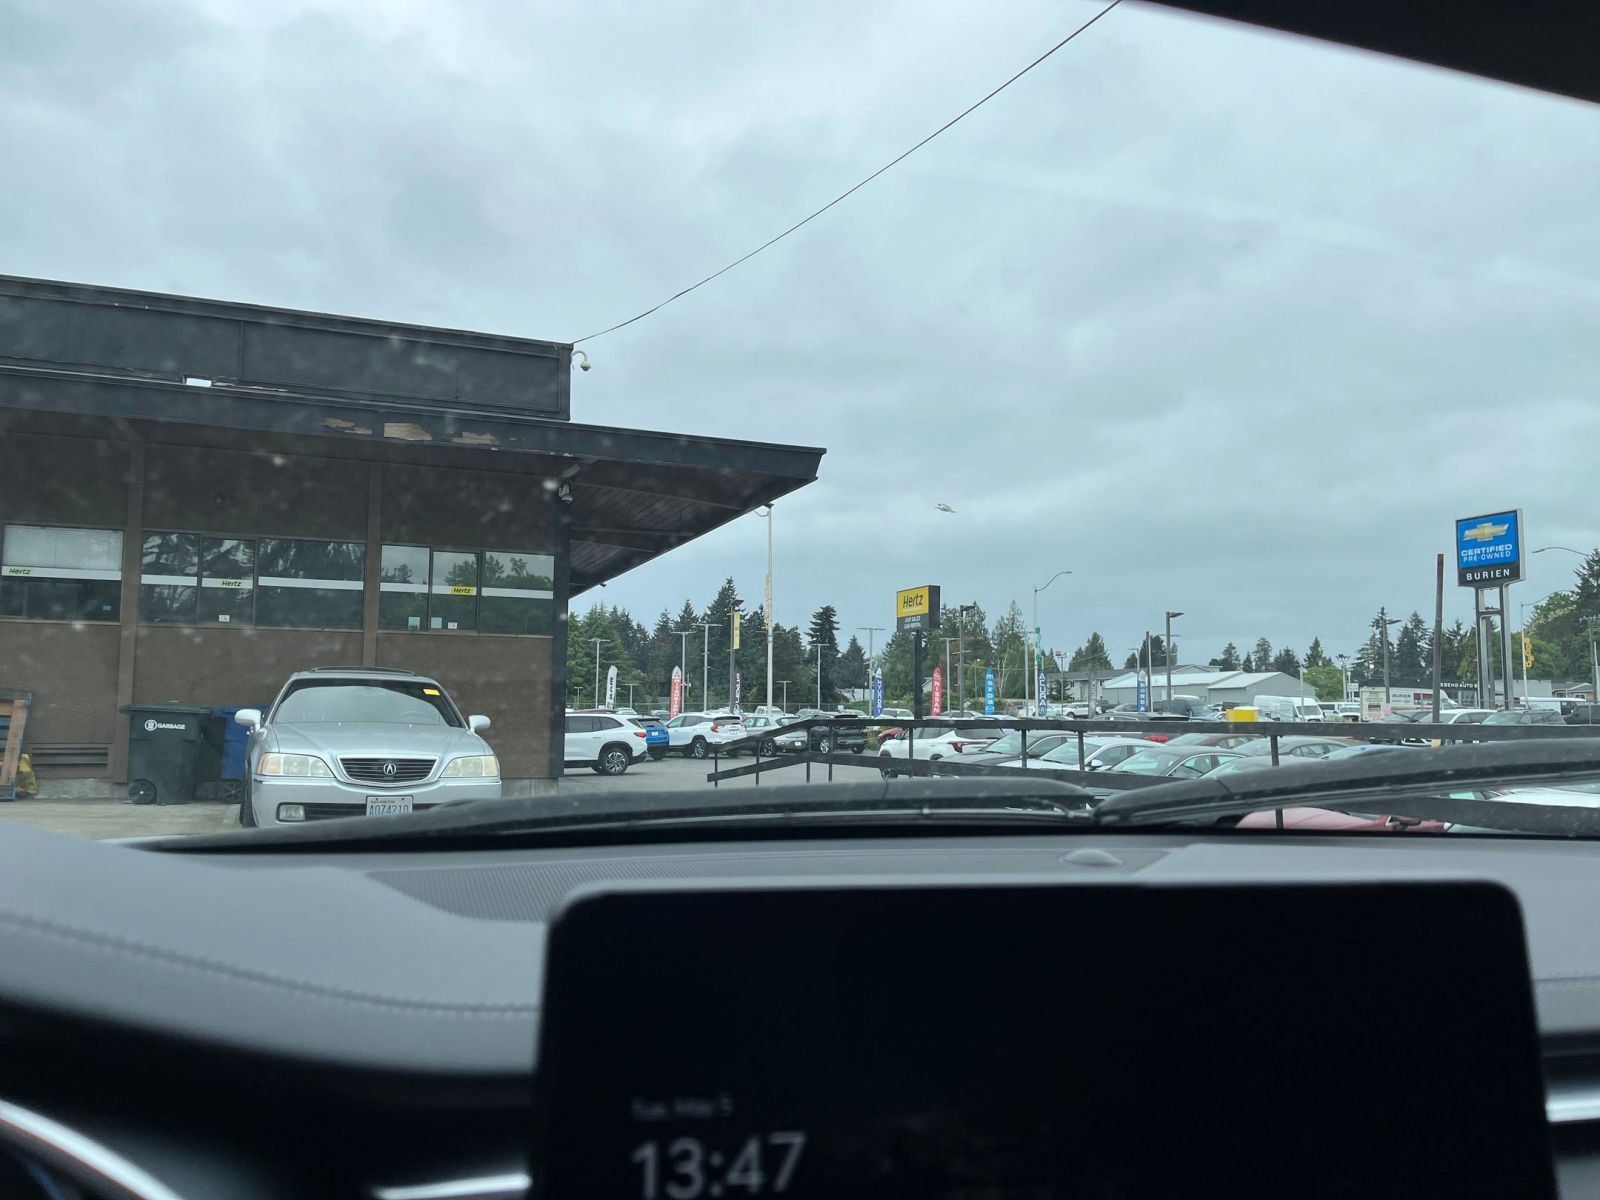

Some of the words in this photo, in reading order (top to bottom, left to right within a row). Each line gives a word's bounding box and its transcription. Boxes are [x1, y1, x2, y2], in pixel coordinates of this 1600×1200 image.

[1461, 544, 1512, 556] CERTIFIED
[1463, 550, 1511, 562] PRE-OWNED
[1466, 569, 1510, 581] BURIEN
[903, 594, 923, 608] Hertz
[631, 1130, 807, 1200] 13:47
